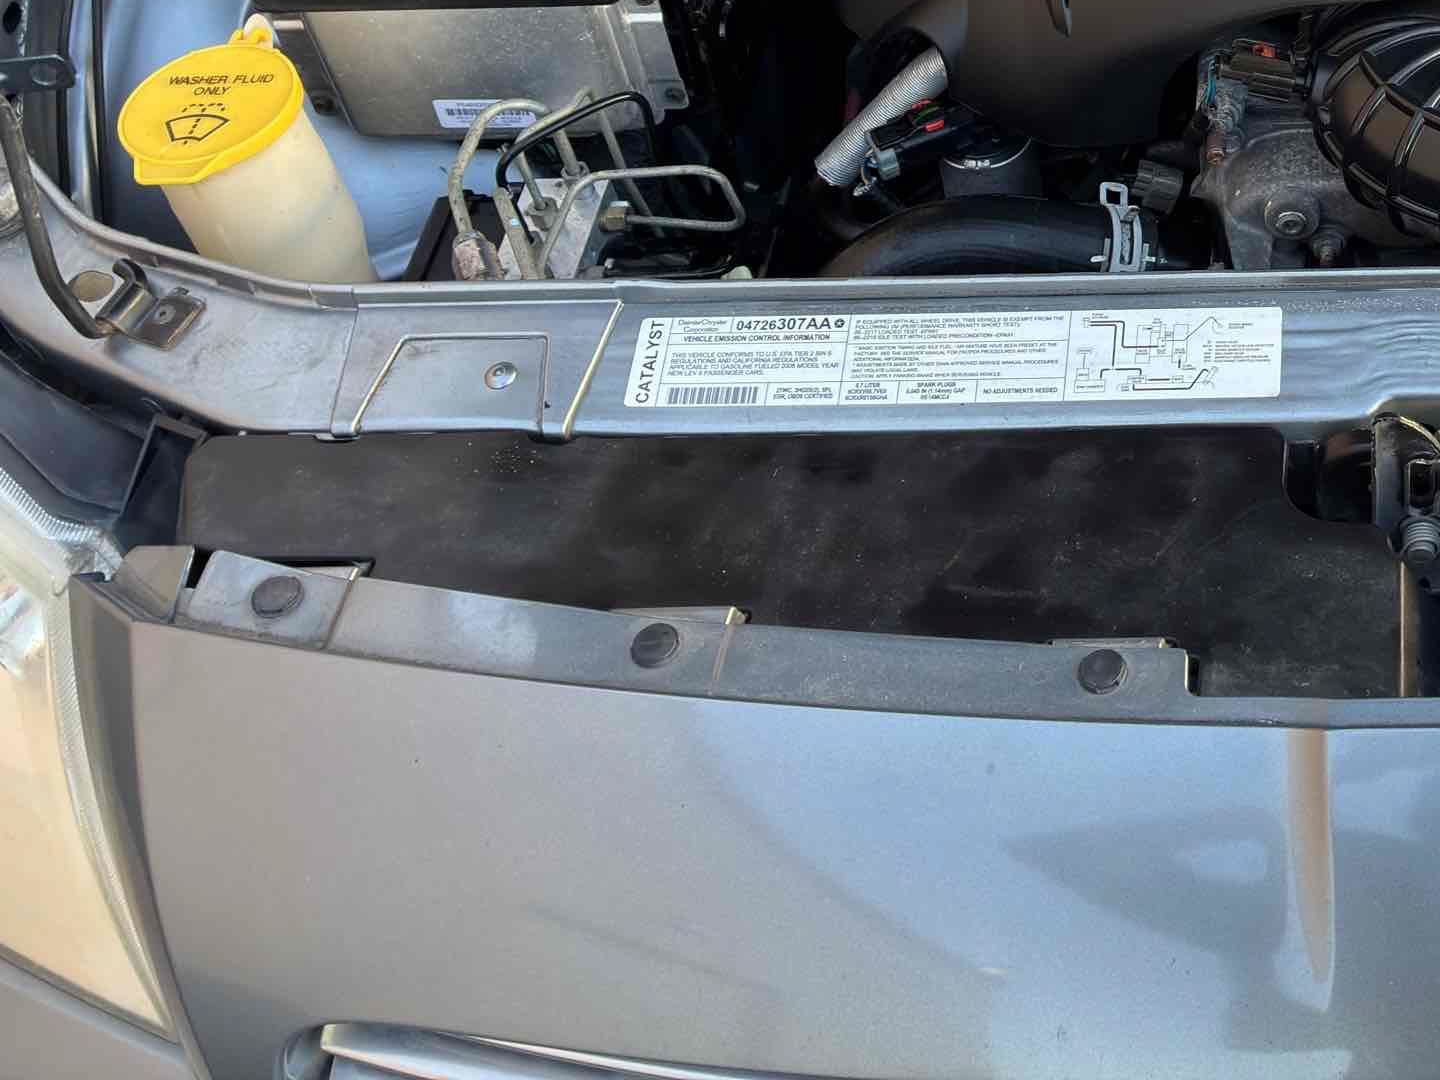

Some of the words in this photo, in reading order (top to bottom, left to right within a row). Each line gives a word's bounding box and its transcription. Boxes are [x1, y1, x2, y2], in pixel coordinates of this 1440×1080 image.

[169, 75, 229, 85] WASHER
[232, 74, 274, 84] FLUID
[193, 86, 231, 96] ONLY
[736, 318, 832, 330] 04726307AA
[635, 320, 665, 404] CATALYST
